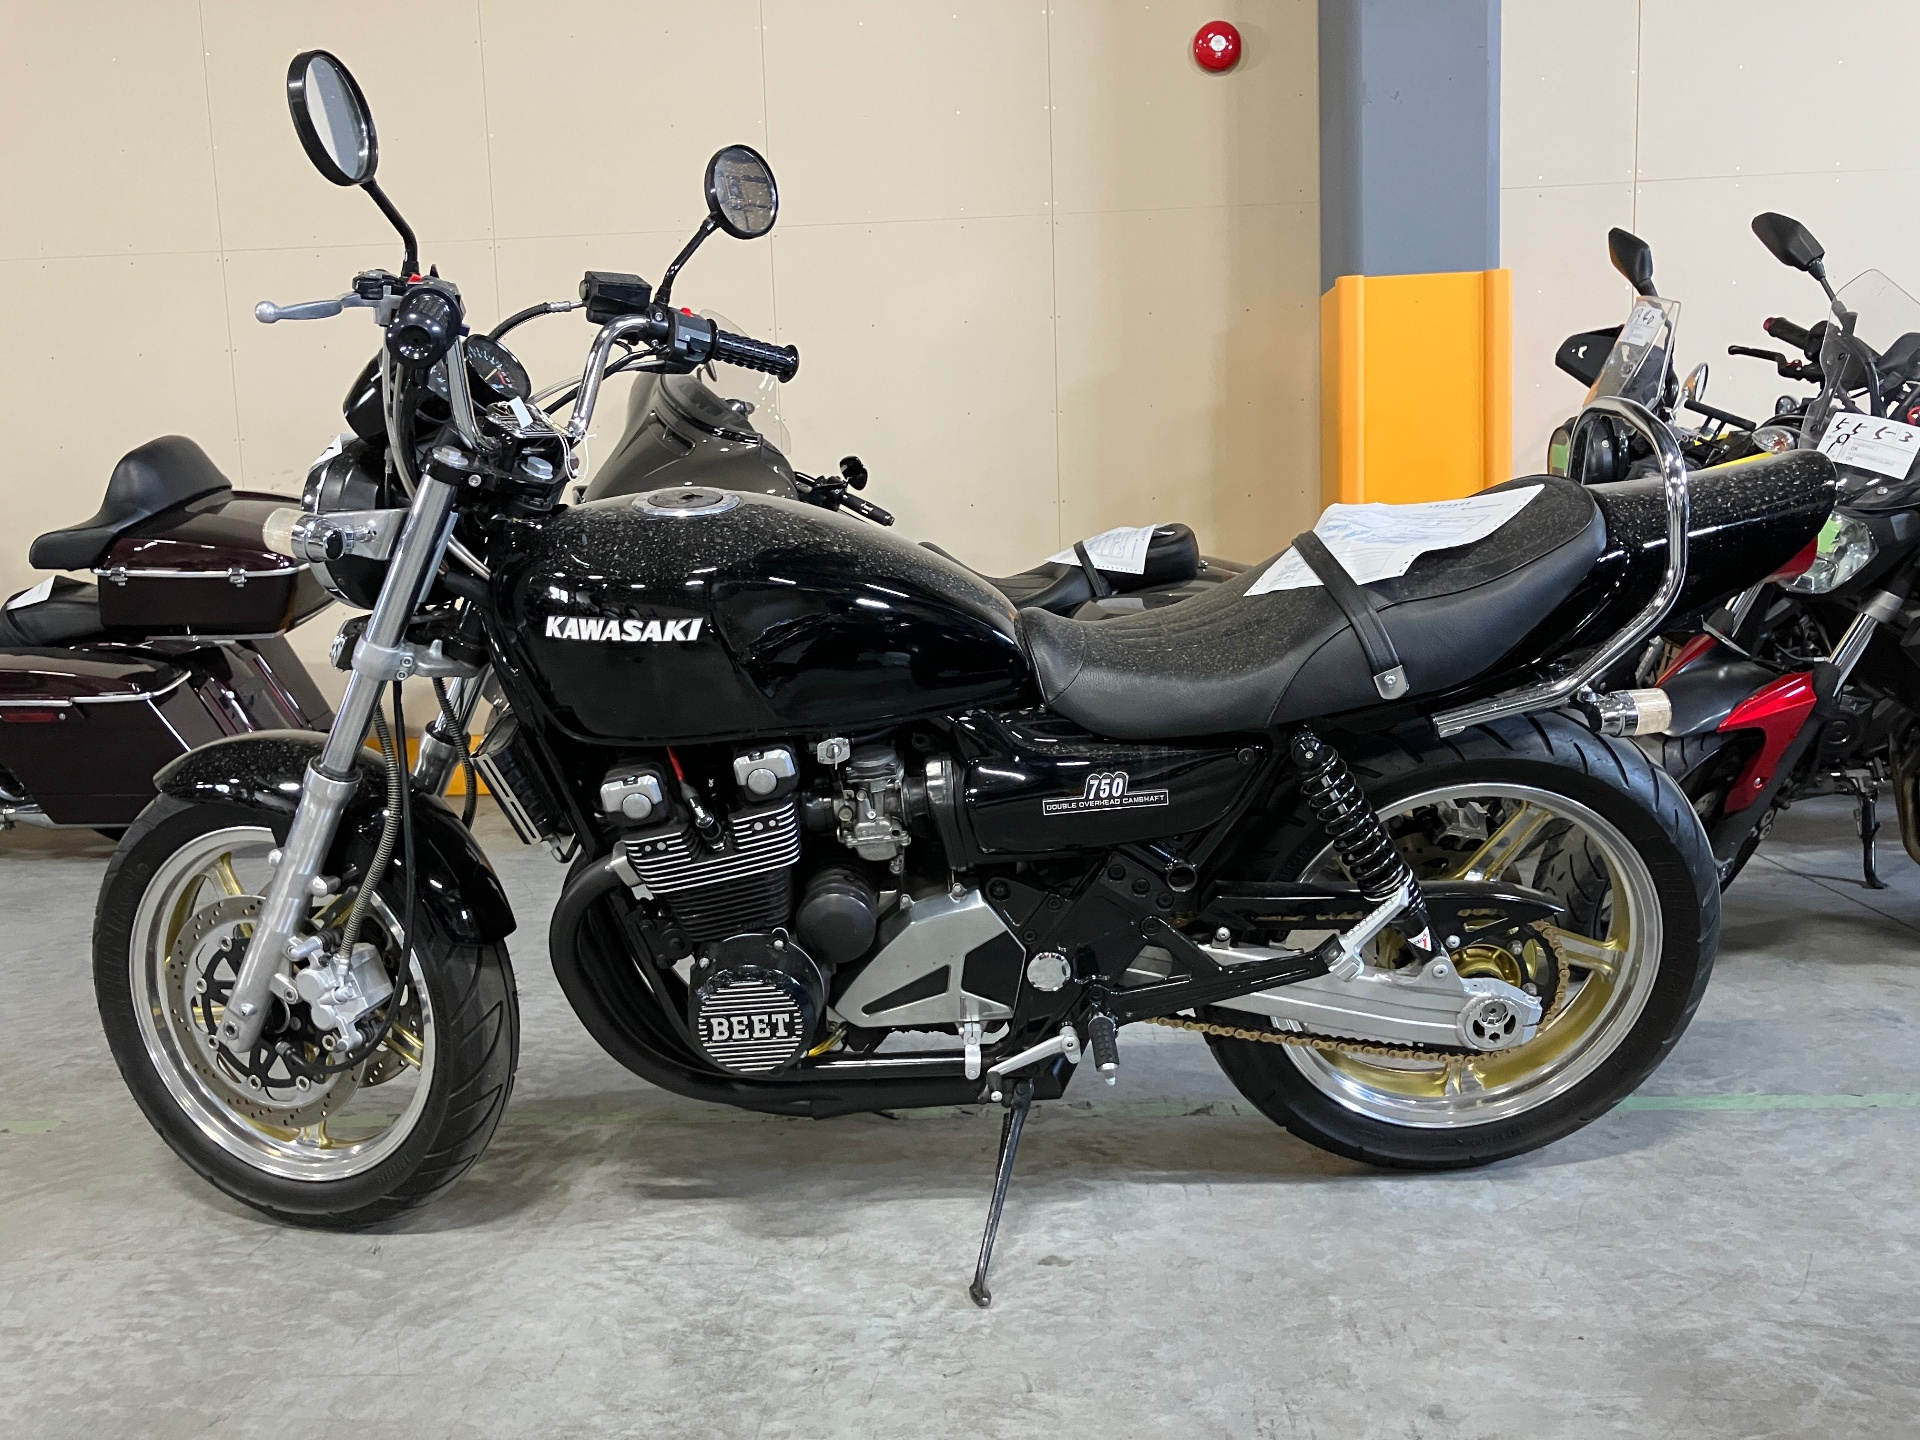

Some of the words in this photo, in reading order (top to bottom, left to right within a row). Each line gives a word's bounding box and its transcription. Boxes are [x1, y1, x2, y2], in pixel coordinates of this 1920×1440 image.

[545, 615, 704, 642] KAWASAKI
[1088, 777, 1124, 800] 750
[1046, 802, 1077, 811] DOUBLE
[1078, 798, 1120, 808] OVERHEAD
[1122, 794, 1165, 804] CAMSHAFT
[710, 1013, 790, 1041] BEET
